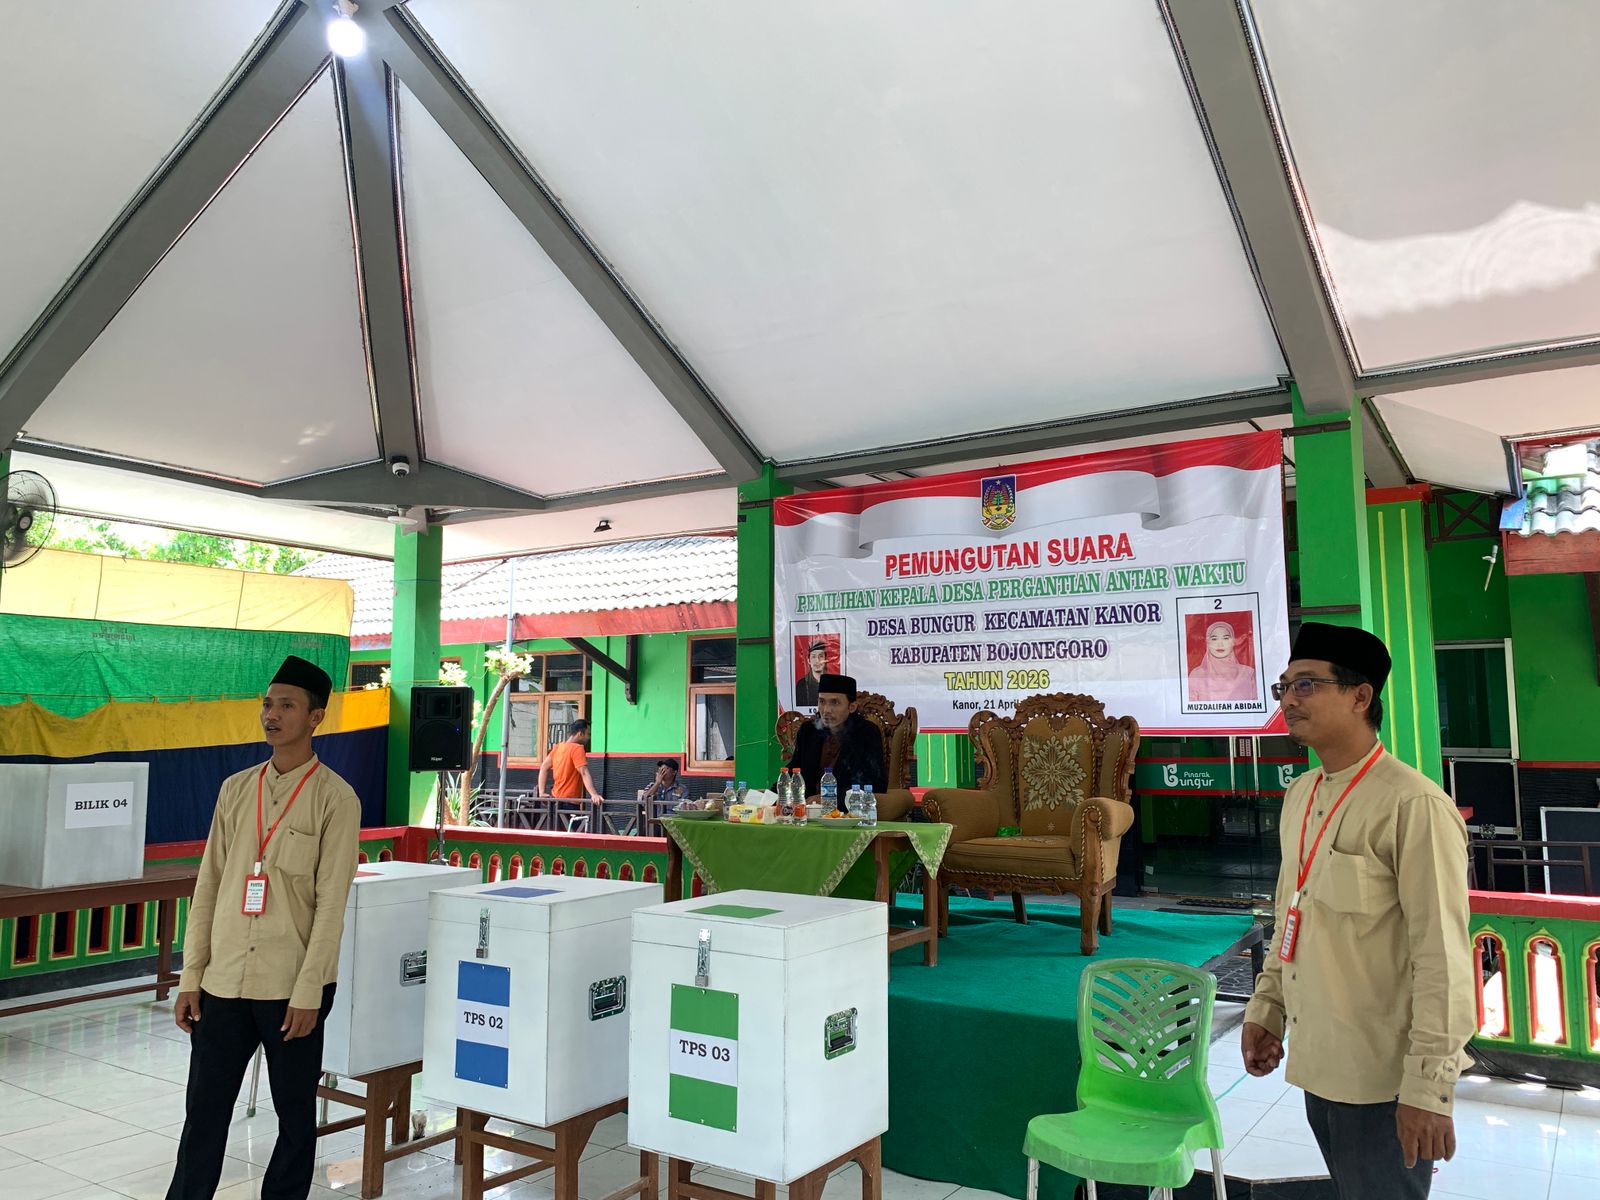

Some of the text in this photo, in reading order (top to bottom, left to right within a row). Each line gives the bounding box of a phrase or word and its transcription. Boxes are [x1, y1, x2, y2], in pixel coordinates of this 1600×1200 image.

[885, 532, 1133, 578] PEMUNGUTAN SUARA
[796, 561, 1246, 613] PEMILIHAN KEPALA DESA PERGANTIAN ANTAR WAKTU
[1214, 599, 1223, 610] 2
[815, 623, 820, 632] 1
[867, 603, 1162, 636] DESA BUNGUR KECAMATAN KANOR
[890, 639, 1109, 665] KABUPATEN BOJONEGORO
[944, 669, 1051, 691] TAHUN 2026
[952, 700, 981, 711] Kanor,
[984, 700, 995, 710] 21
[74, 798, 128, 811] BILIK 04
[463, 1011, 503, 1030] TPS 02
[679, 1039, 731, 1062] TPS 03
